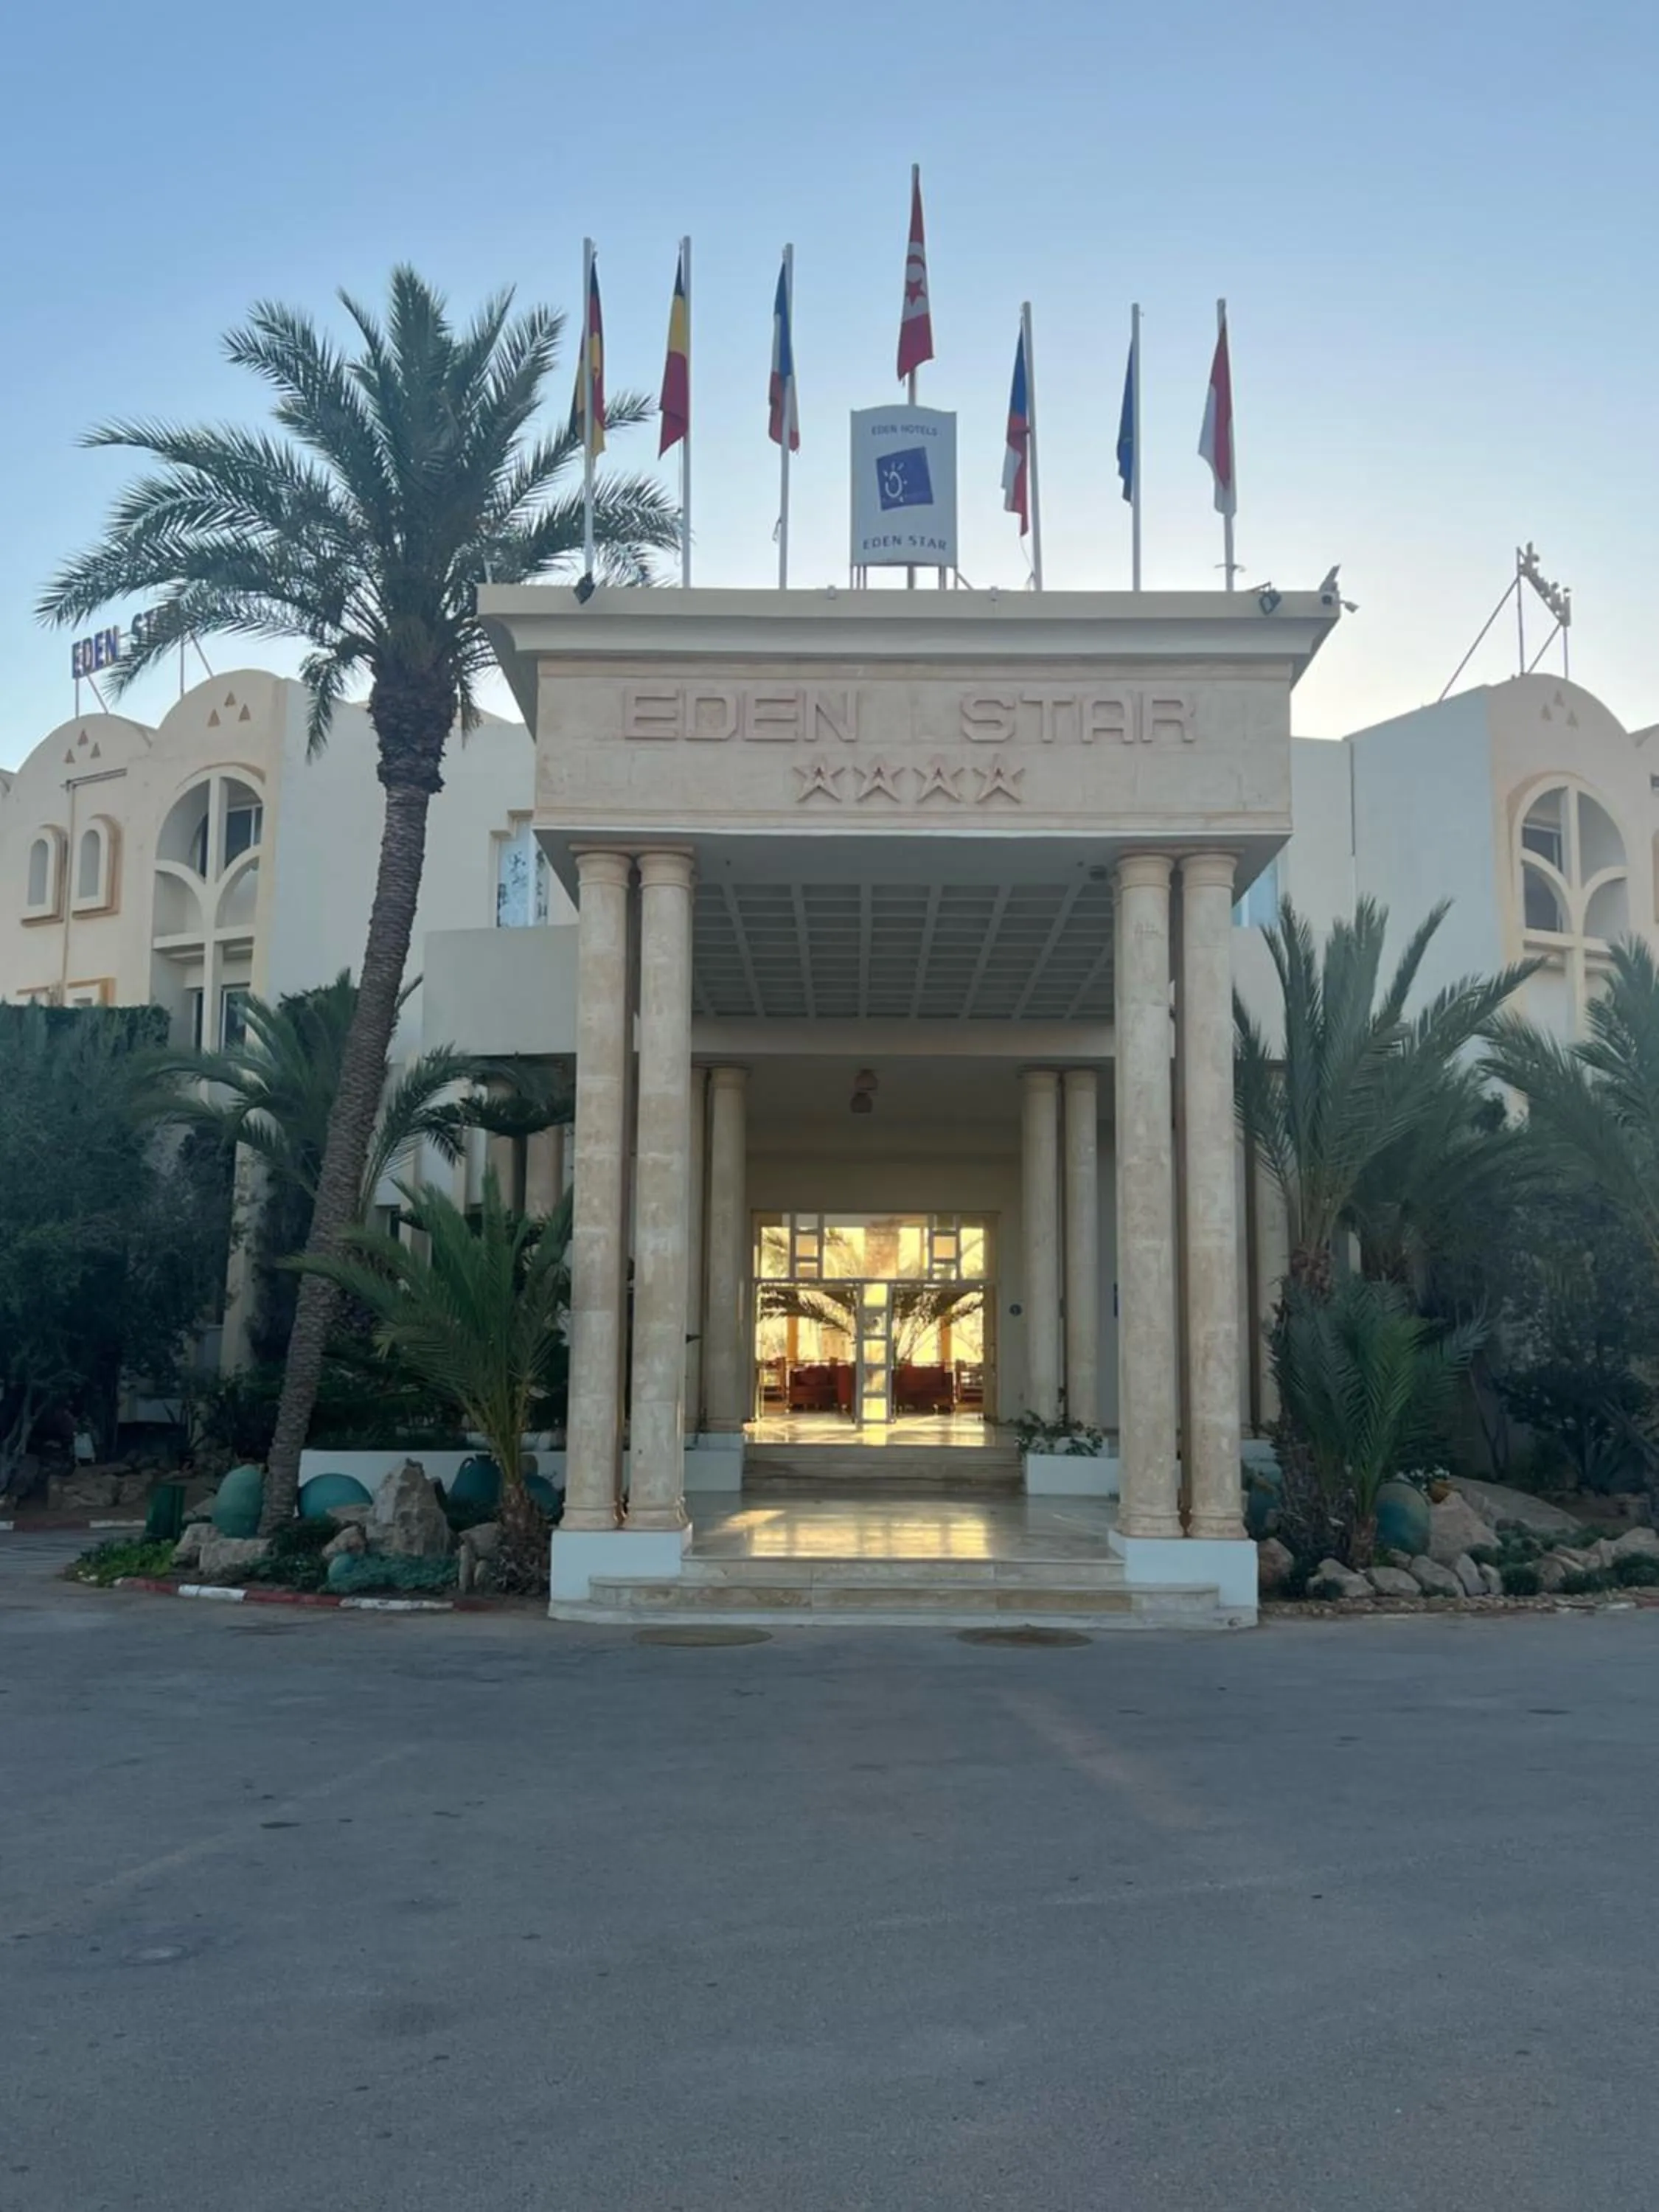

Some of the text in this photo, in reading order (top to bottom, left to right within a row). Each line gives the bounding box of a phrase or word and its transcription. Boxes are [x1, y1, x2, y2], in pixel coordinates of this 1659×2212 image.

[872, 425, 938, 437] EDEN HOTELS
[863, 535, 947, 551] EDEN STAR
[72, 625, 119, 679] EDEN
[624, 689, 1197, 745] EDEN STAR
